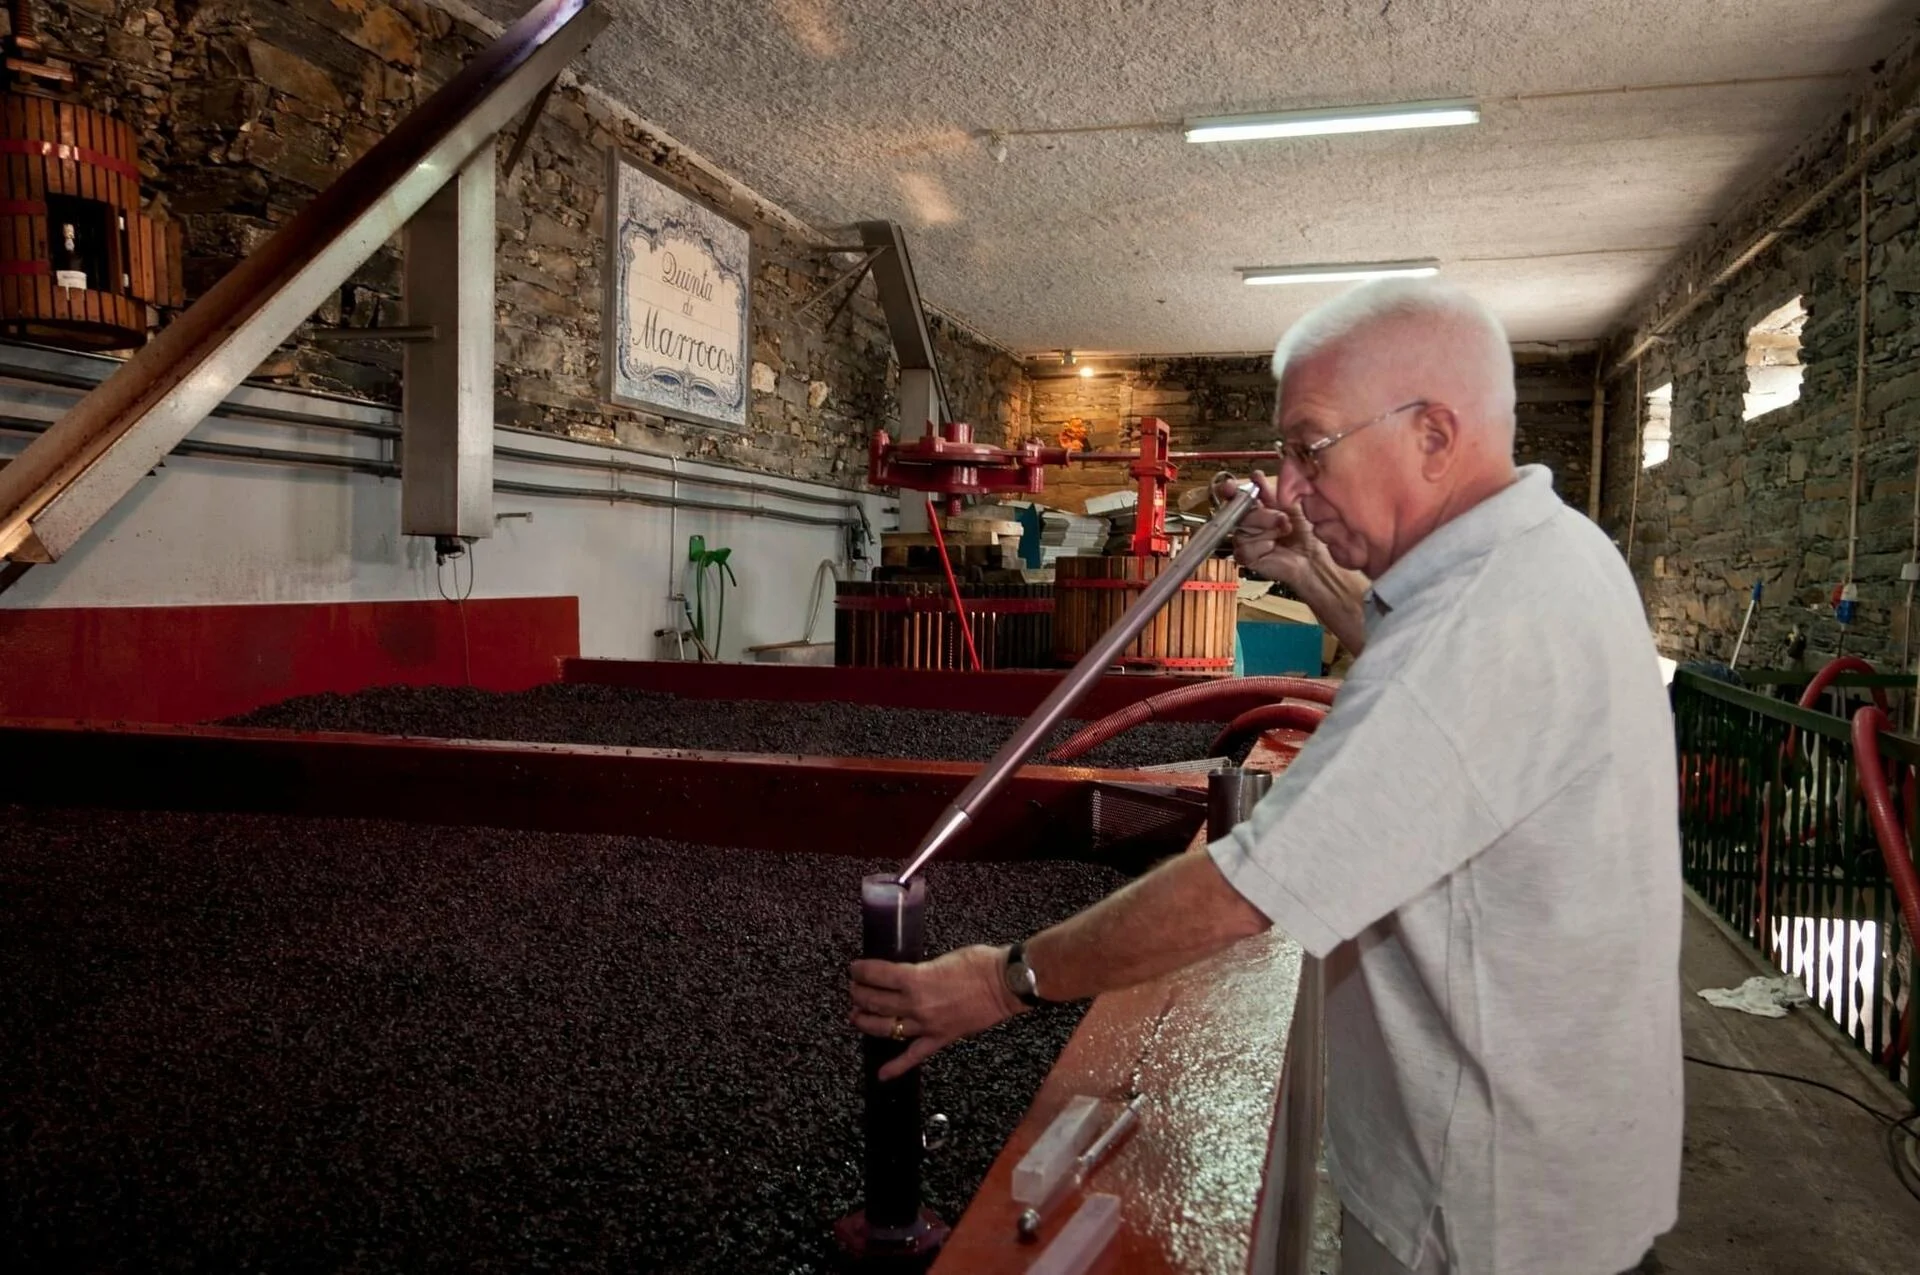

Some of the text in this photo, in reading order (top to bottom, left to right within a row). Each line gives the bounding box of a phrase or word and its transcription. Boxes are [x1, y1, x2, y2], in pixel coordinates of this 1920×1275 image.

[662, 251, 712, 301] Quinta
[682, 297, 694, 316] de
[632, 306, 735, 376] Marrocos
